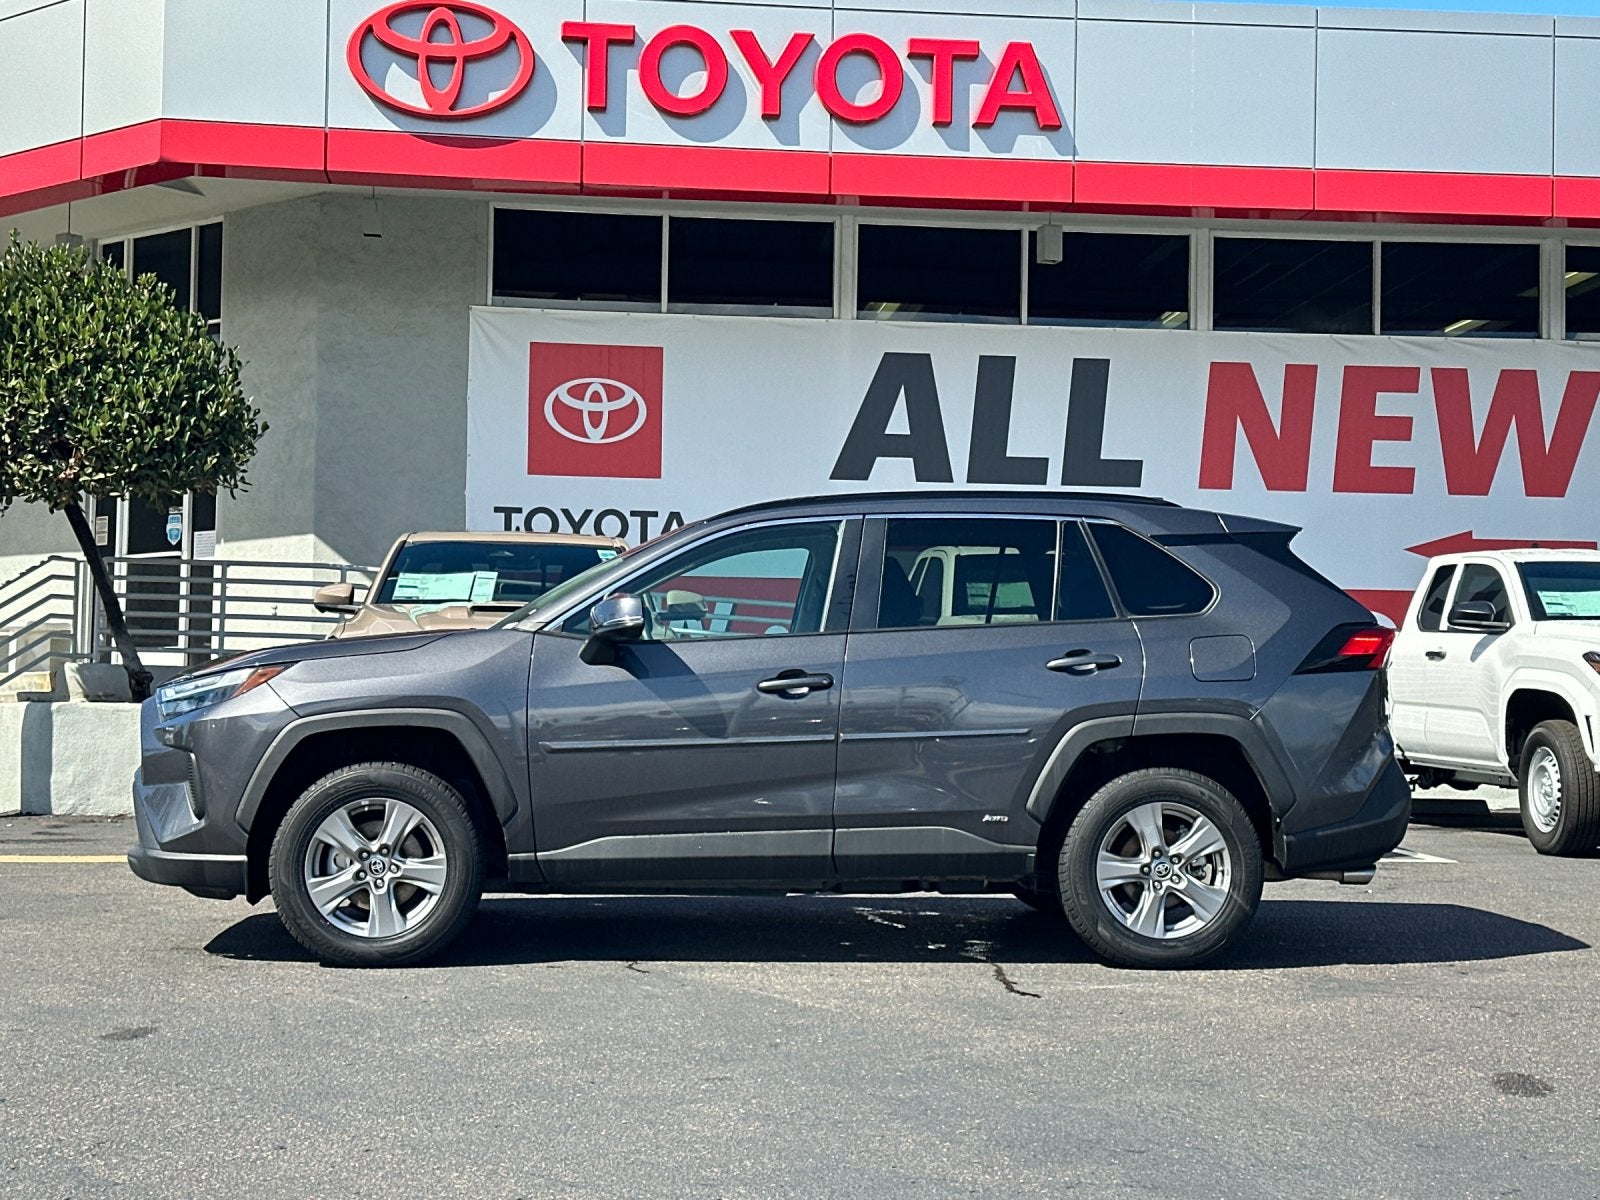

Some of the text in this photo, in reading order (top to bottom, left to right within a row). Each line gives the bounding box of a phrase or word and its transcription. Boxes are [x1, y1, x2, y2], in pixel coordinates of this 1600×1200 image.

[561, 20, 1062, 130] TOYOTA
[829, 352, 1600, 498] ALL NEW
